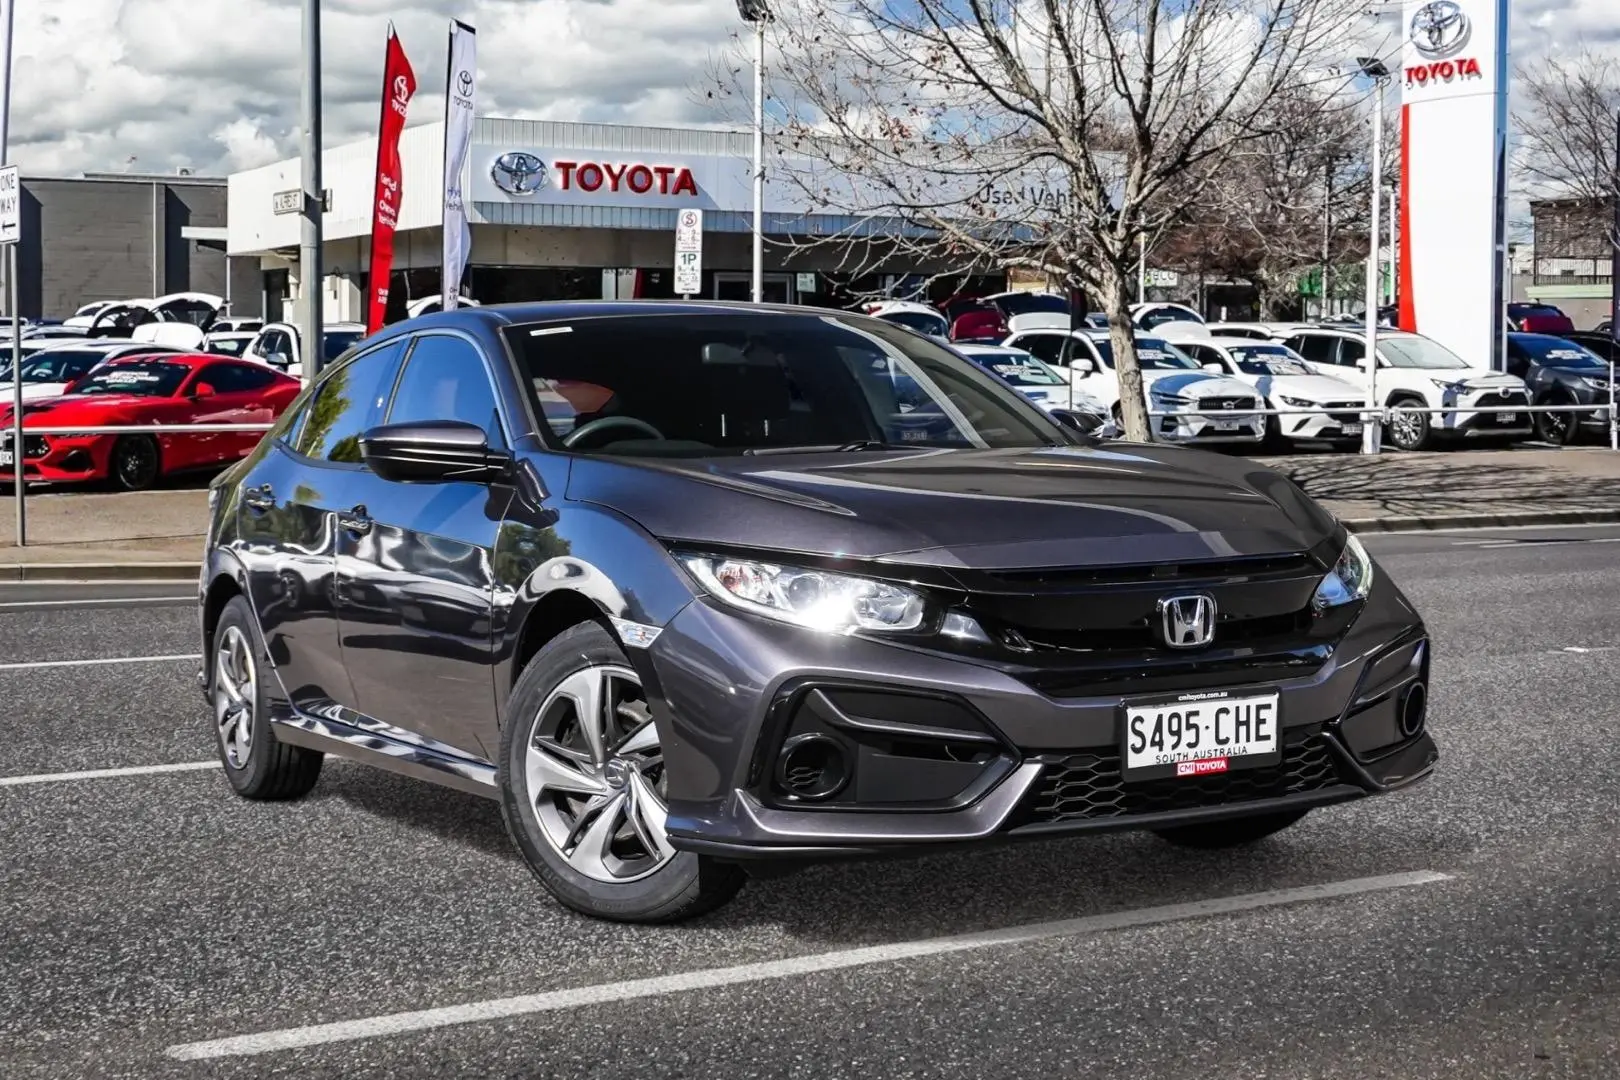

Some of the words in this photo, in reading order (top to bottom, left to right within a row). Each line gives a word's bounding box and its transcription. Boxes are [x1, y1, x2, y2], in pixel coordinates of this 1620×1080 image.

[1404, 58, 1481, 83] TOYOTA
[0, 173, 15, 191] ONE
[555, 161, 698, 196] TOYOTA
[0, 196, 16, 214] WAY
[1031, 187, 1067, 206] Veh
[681, 253, 697, 264] 1P
[1178, 691, 1229, 702] cmitoyota.com.au
[1155, 752, 1189, 764] SOUTH
[1193, 746, 1248, 760] AUSTRALIA
[1179, 764, 1195, 773] CMI
[1196, 761, 1226, 771] TOYOTA
